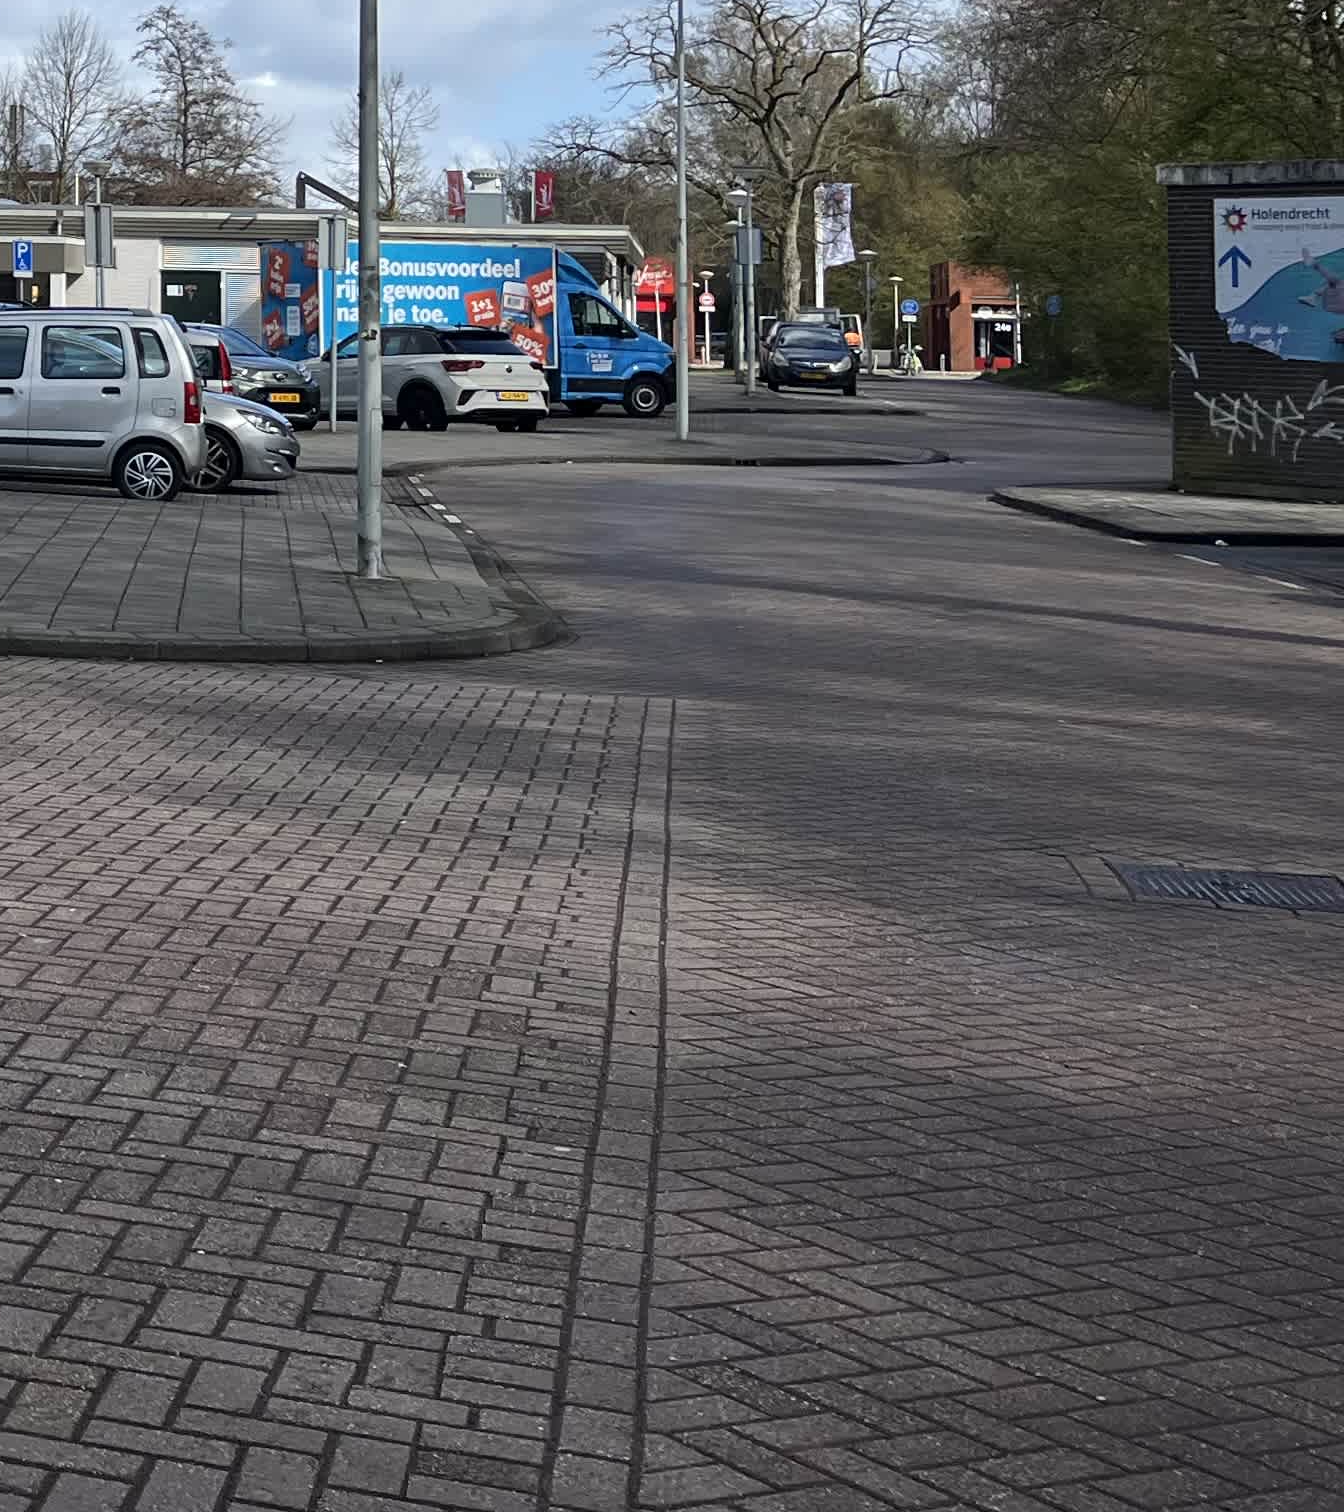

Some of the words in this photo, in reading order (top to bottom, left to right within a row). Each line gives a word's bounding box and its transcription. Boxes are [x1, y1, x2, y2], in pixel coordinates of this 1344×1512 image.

[1251, 208, 1330, 220] Holendrecht
[17, 242, 28, 258] P
[379, 257, 520, 278] Bonusvoordeel
[382, 284, 459, 304] gewoon
[388, 304, 405, 324] je
[411, 305, 448, 322] toe.
[471, 298, 494, 312] 1+1
[515, 334, 544, 356] 50%
